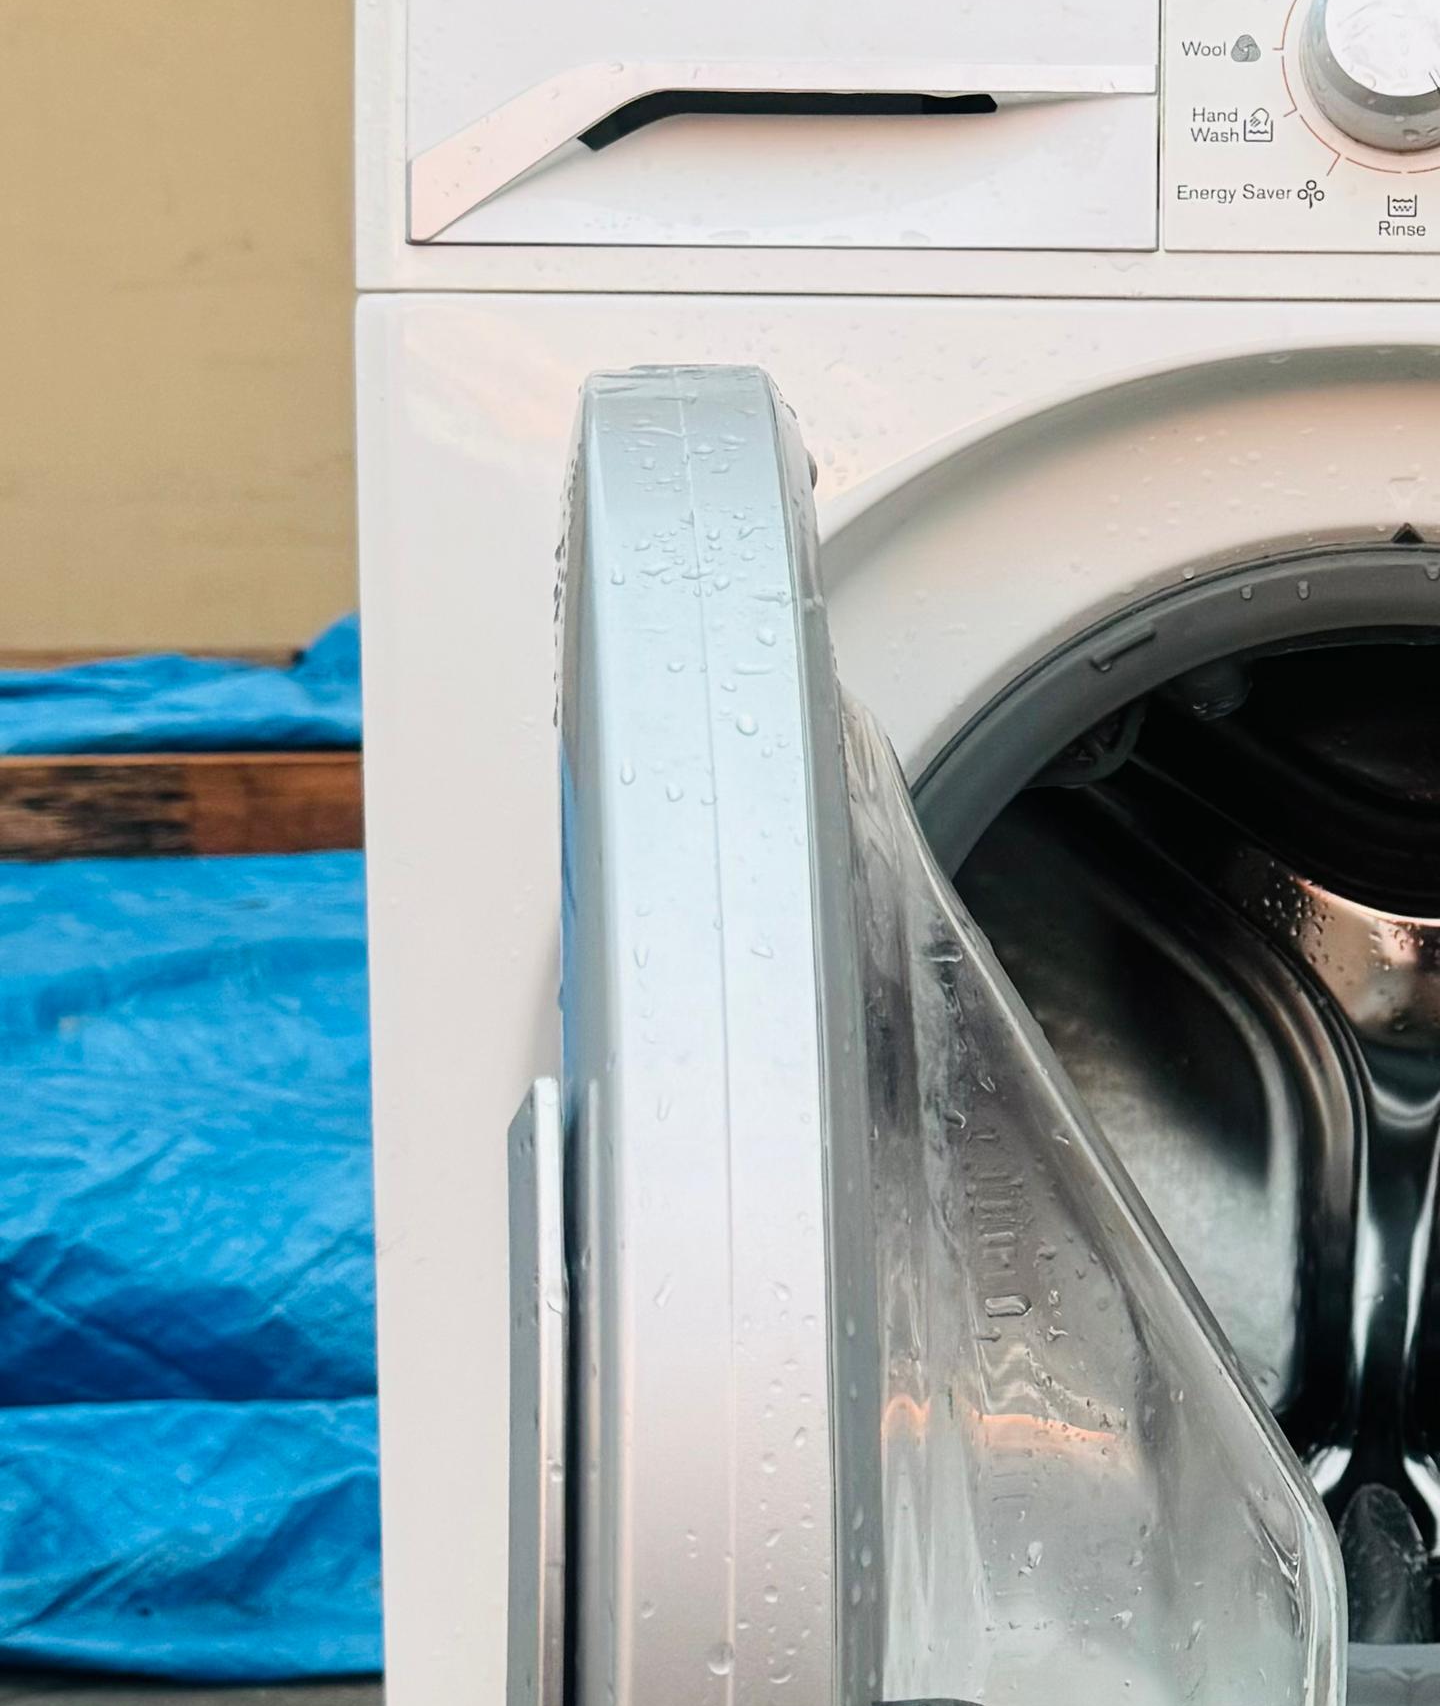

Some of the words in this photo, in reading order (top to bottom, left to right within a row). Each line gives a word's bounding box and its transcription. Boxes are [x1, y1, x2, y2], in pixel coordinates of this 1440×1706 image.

[1181, 42, 1226, 57] Wool
[1192, 107, 1238, 123] Hand
[1191, 127, 1239, 143] Wash
[1177, 185, 1236, 204] Energy
[1243, 184, 1291, 200] Saver
[1378, 221, 1426, 236] Rinse
